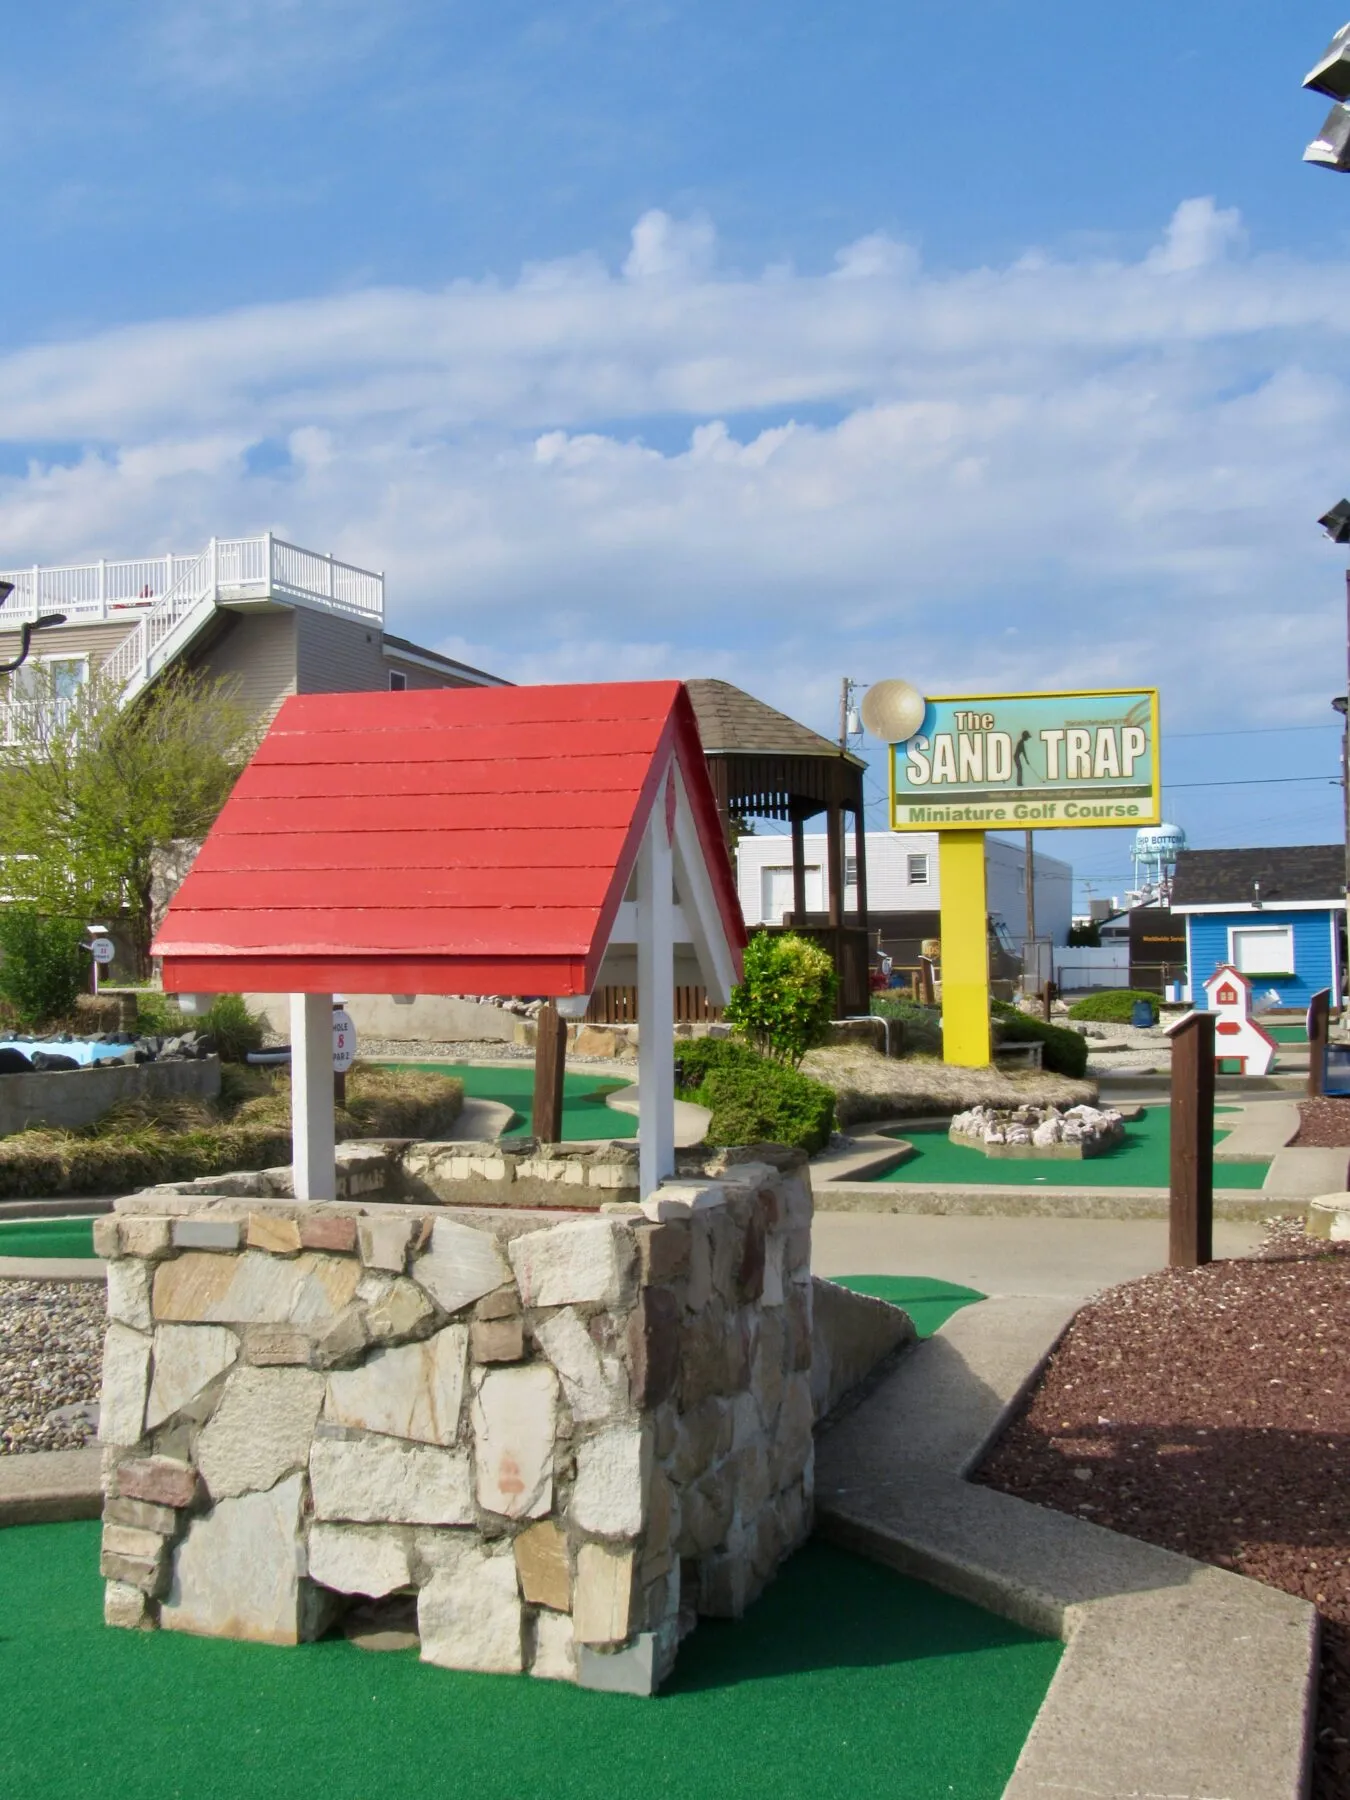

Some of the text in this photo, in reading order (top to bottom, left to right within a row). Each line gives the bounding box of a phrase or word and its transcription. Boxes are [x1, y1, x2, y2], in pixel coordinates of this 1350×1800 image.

[954, 711, 995, 731] The
[905, 726, 1147, 786] SAND TRAP
[908, 802, 1140, 823] Miniature Golf Course
